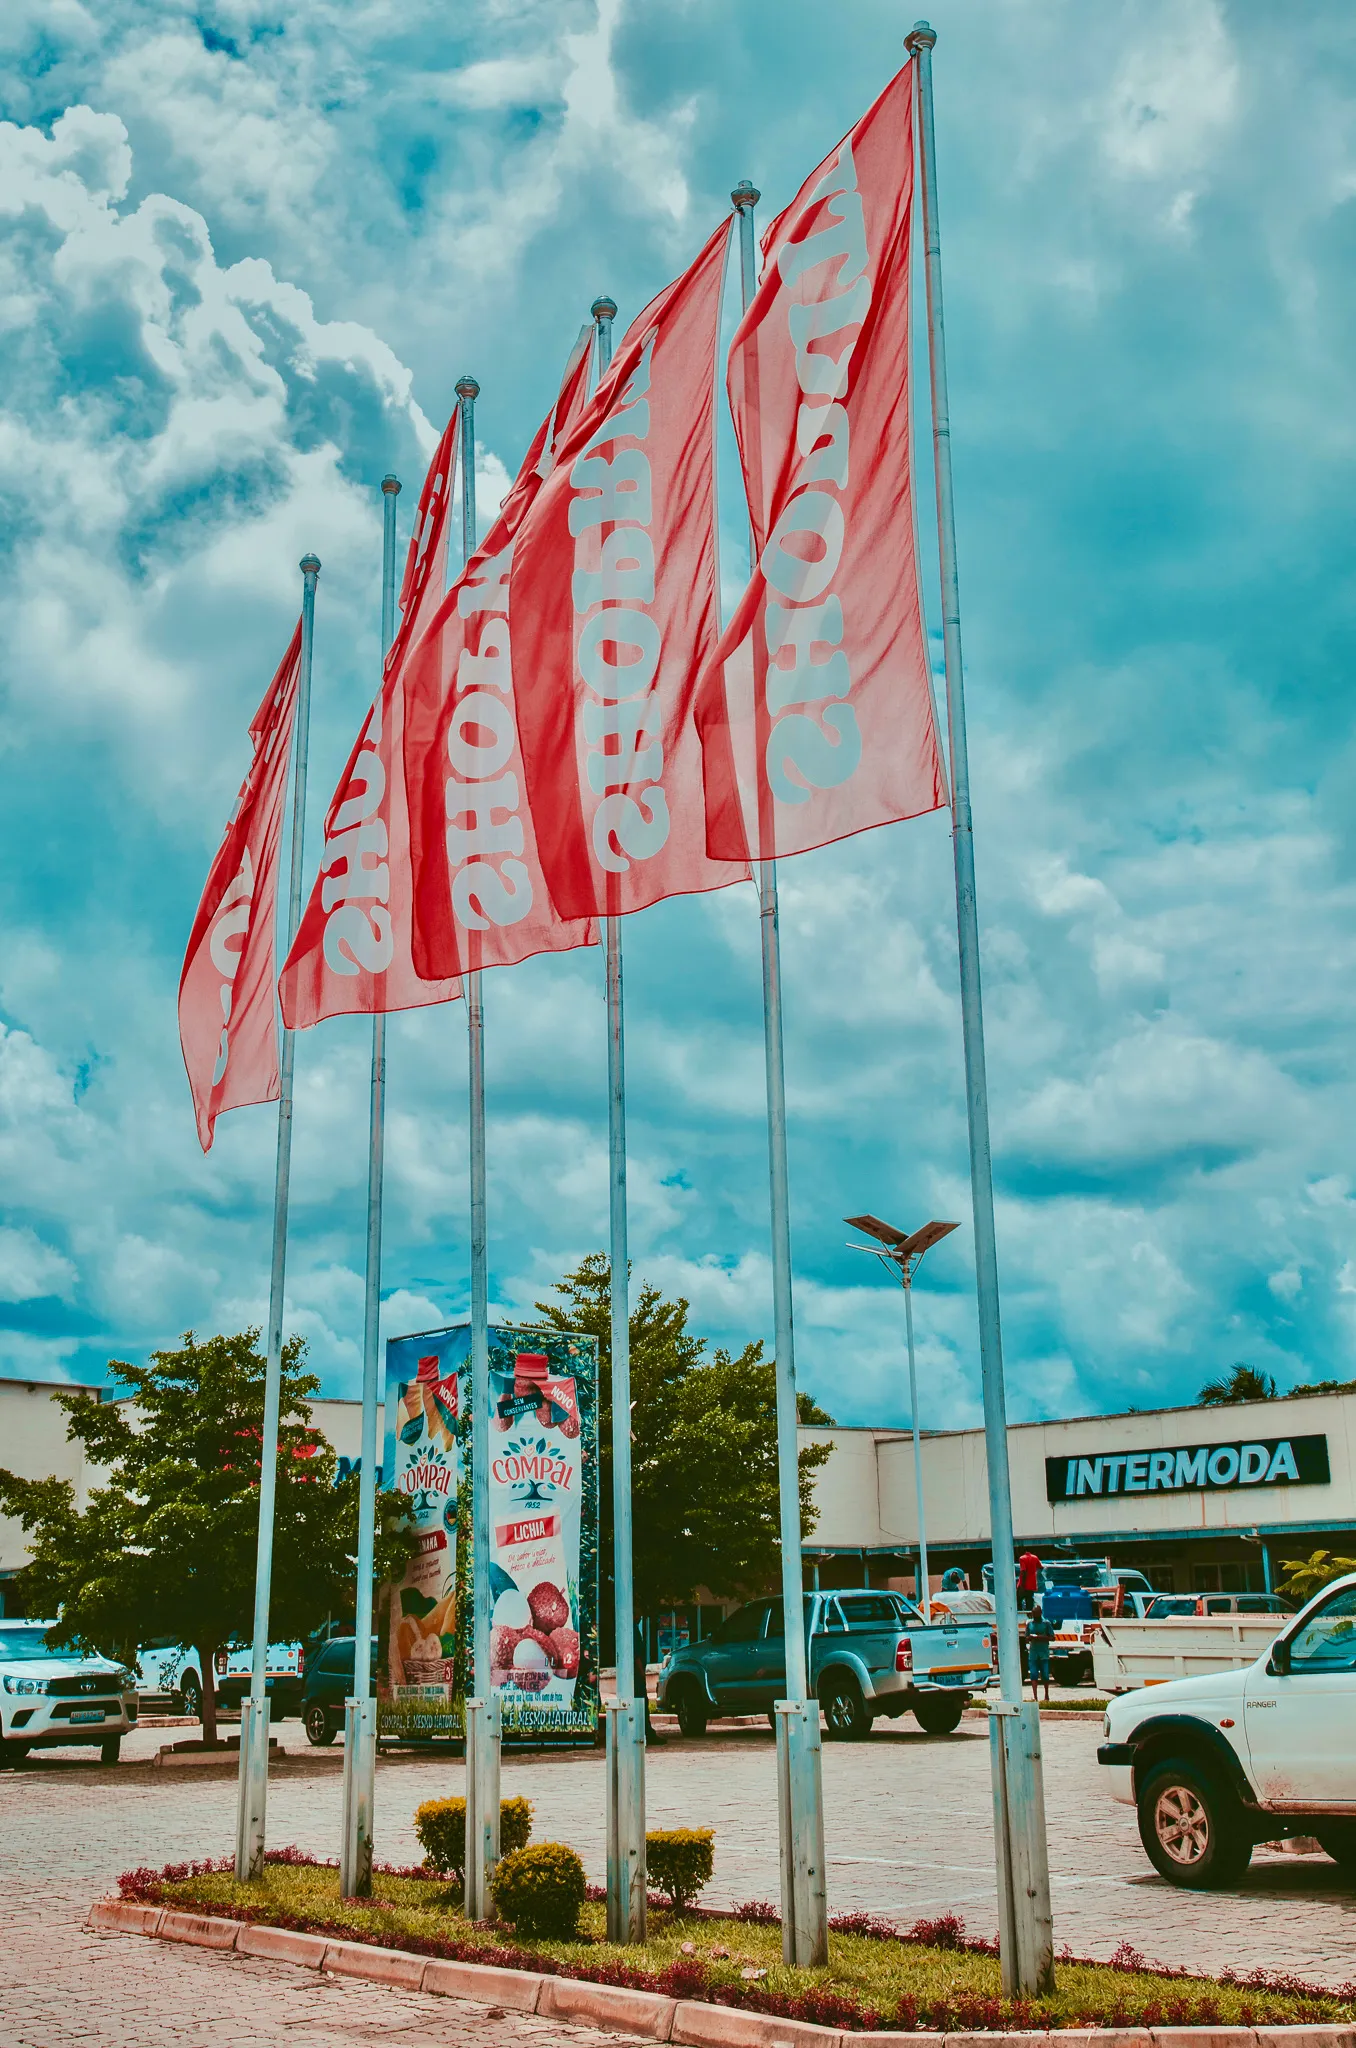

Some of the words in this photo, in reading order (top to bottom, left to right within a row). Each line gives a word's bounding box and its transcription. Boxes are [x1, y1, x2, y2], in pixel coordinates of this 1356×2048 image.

[438, 1384, 456, 1409] NOVO
[514, 1397, 524, 1405] SEM
[550, 1385, 574, 1409] NOVO
[503, 1402, 538, 1415] CONSERVANTES
[1065, 1441, 1300, 1496] INTERMODA
[524, 1501, 541, 1509] 1952
[513, 1521, 547, 1541] LICHIA
[1246, 1700, 1277, 1709] RANGER
[518, 1711, 546, 1726] MESMO
[548, 1711, 592, 1726] NATURAL.
